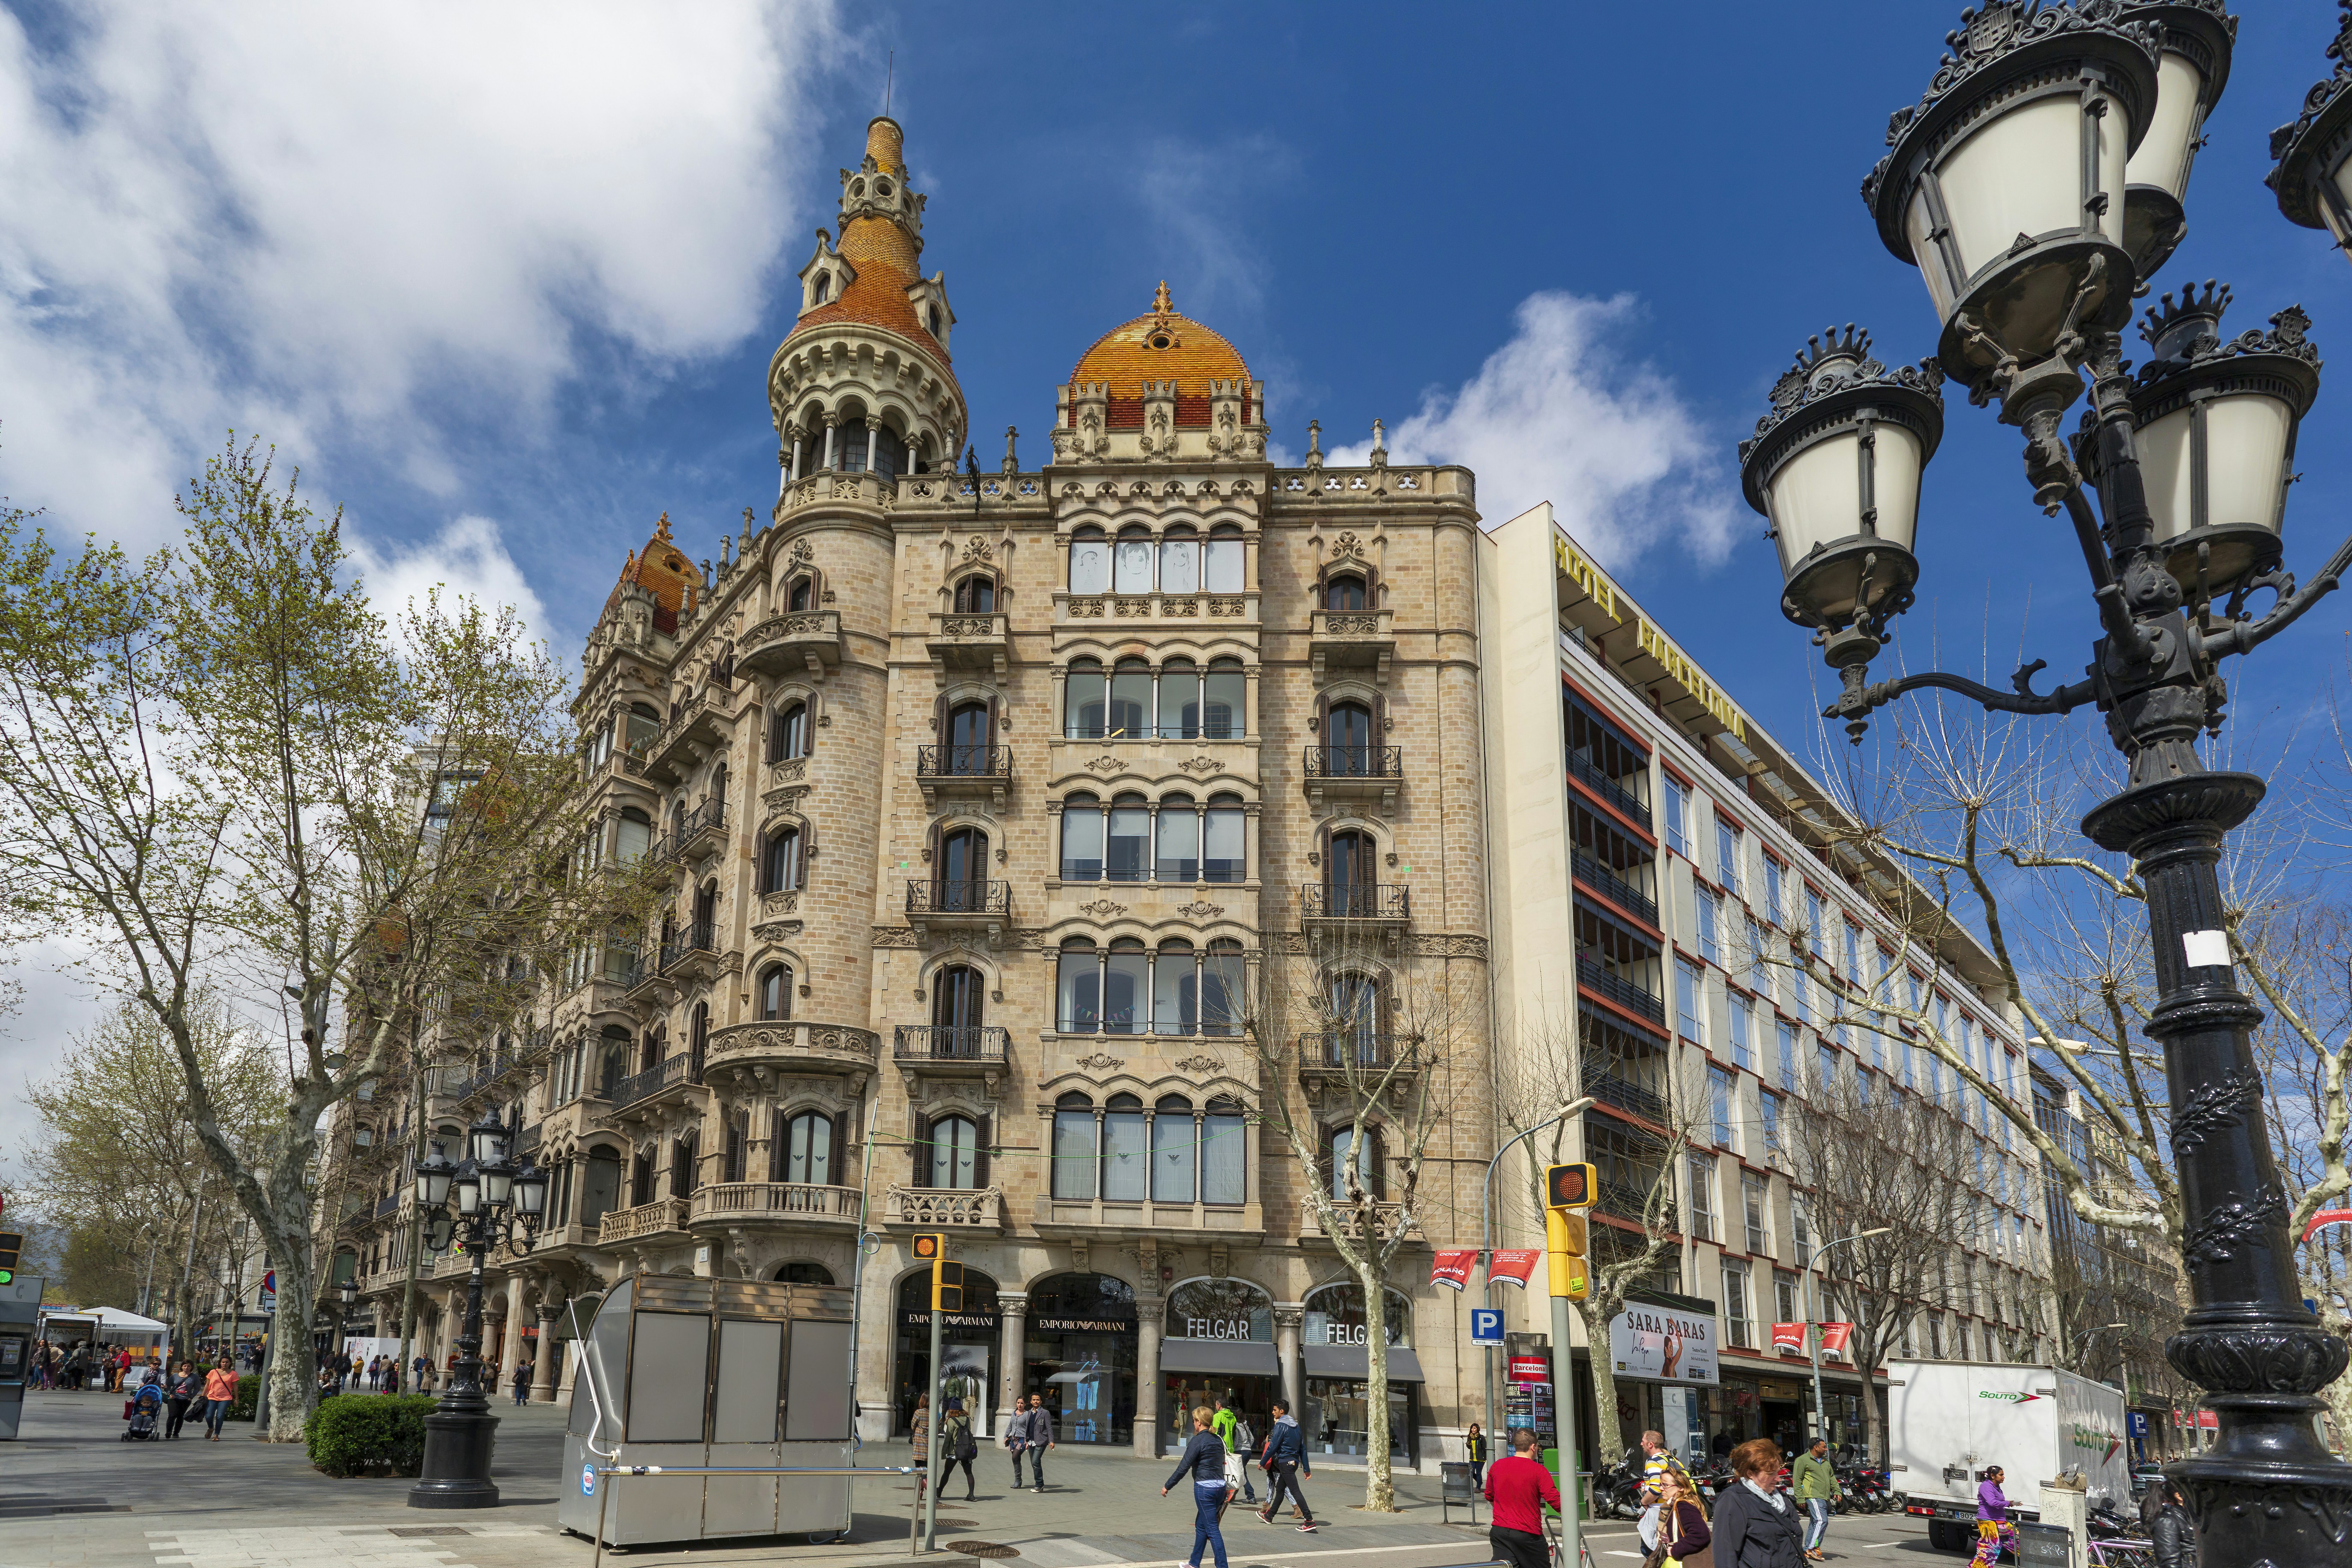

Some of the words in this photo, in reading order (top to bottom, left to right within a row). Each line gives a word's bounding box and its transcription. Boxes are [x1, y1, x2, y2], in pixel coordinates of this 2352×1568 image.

[1554, 531, 1622, 625] HOTEL
[1638, 618, 1746, 745] BARCELONA
[1433, 1267, 1465, 1276] BOLAÑO
[909, 1314, 948, 1324] EMPOO
[959, 1317, 993, 1326] ARMANI
[1039, 1319, 1079, 1330] EMPORIO
[1091, 1322, 1125, 1331] ARMANI
[1187, 1318, 1250, 1340] FELGAR
[1478, 1312, 1497, 1336] P
[1627, 1311, 1663, 1334] SARA
[1666, 1318, 1705, 1341] BARAS
[1326, 1324, 1390, 1345] FELGR
[1979, 1391, 2017, 1400] SOUTO
[2134, 1415, 2144, 1428] P
[2074, 1423, 2104, 1451] SOUTO
